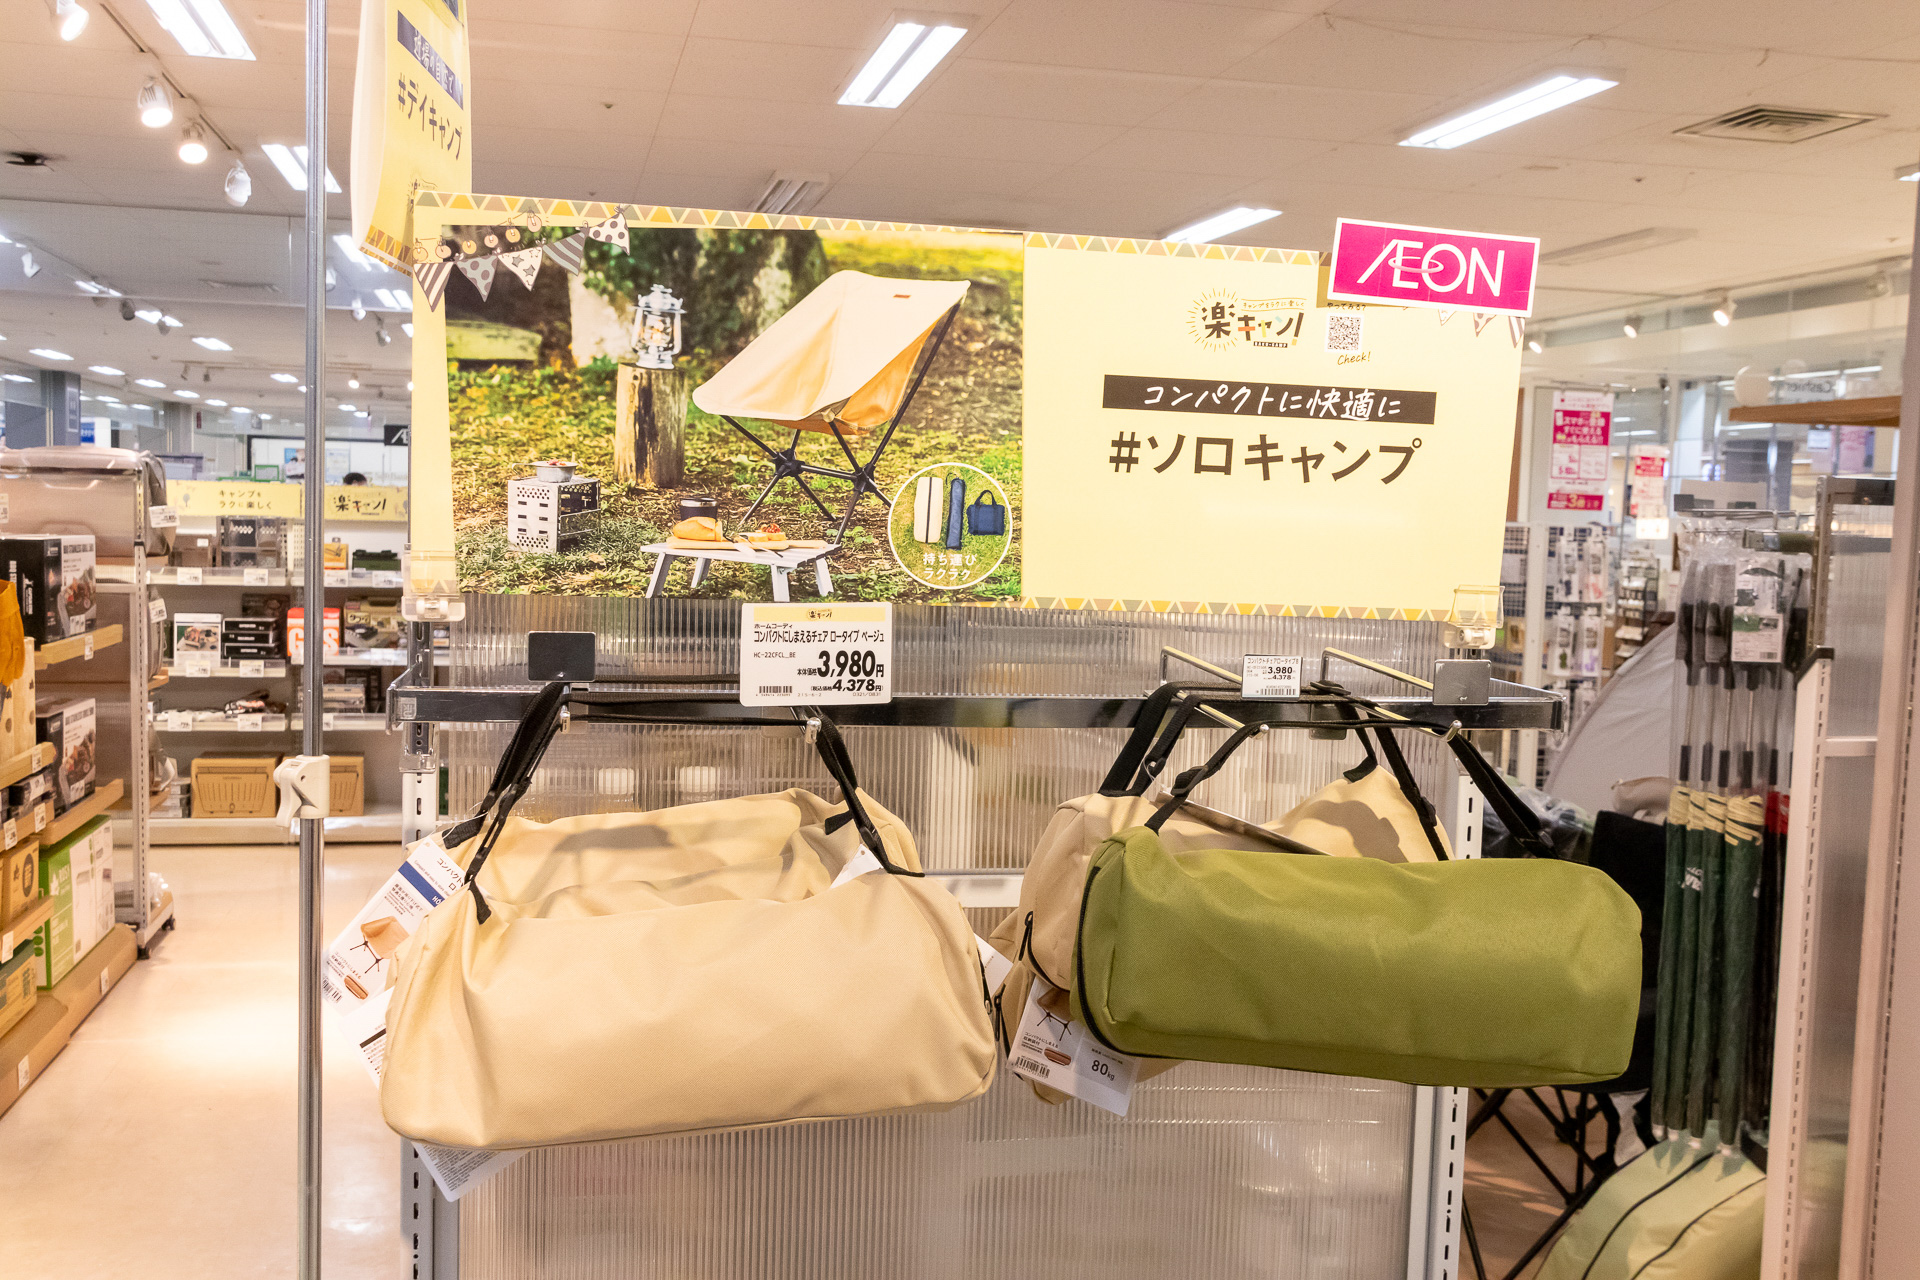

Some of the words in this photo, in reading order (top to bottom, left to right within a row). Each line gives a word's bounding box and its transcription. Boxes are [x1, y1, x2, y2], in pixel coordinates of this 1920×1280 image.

[398, 72, 462, 161] #デイキャンプ
[1337, 351, 1371, 366] Check!
[1144, 384, 1402, 422] コンパクトに快適に
[1109, 431, 1423, 485] #ソロキャンプ
[922, 553, 977, 566] 持ち運び
[923, 568, 971, 581] ラクラク
[754, 630, 828, 644] コンパクトにしまえるチェア
[830, 630, 859, 643] ロータイプ
[861, 630, 885, 643] ベージュ
[1091, 1060, 1115, 1081] 80kg
